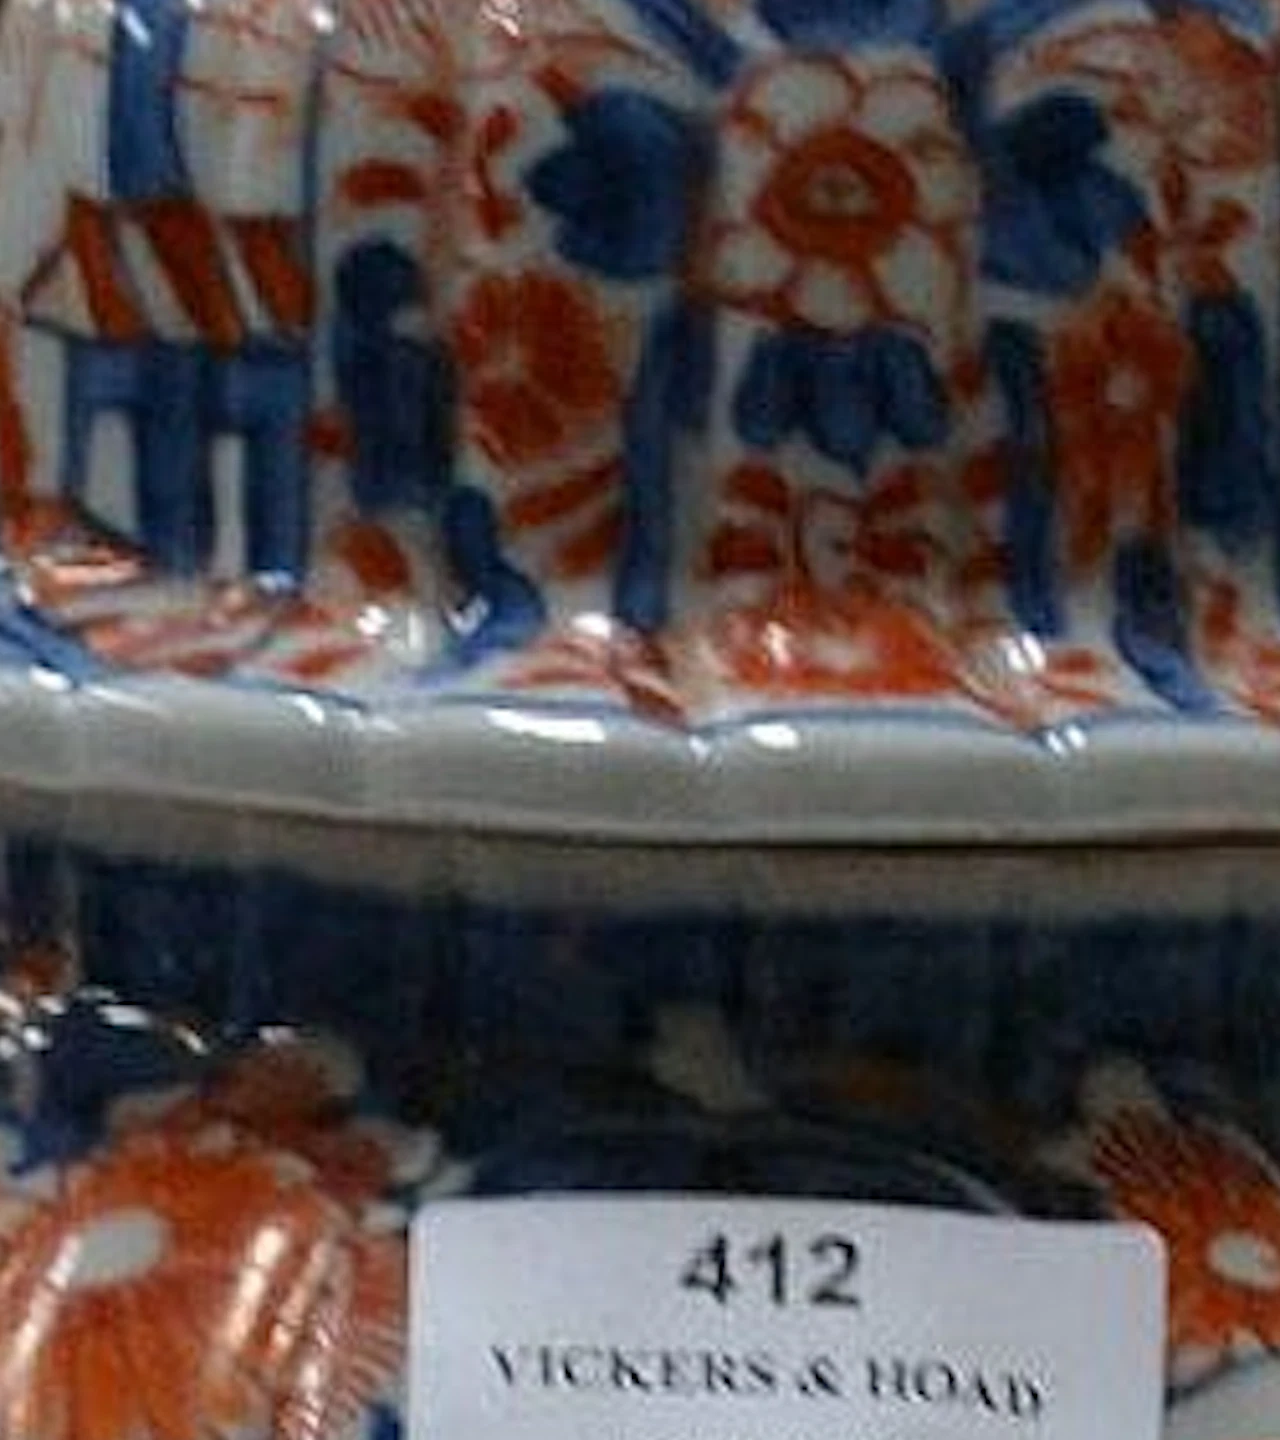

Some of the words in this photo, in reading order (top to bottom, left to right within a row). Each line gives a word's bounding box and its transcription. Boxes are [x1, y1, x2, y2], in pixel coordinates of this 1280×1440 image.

[680, 1232, 862, 1309] 412
[489, 1343, 776, 1396] VICKERS
[798, 1357, 841, 1399] &
[866, 1356, 1044, 1421] HOAD
